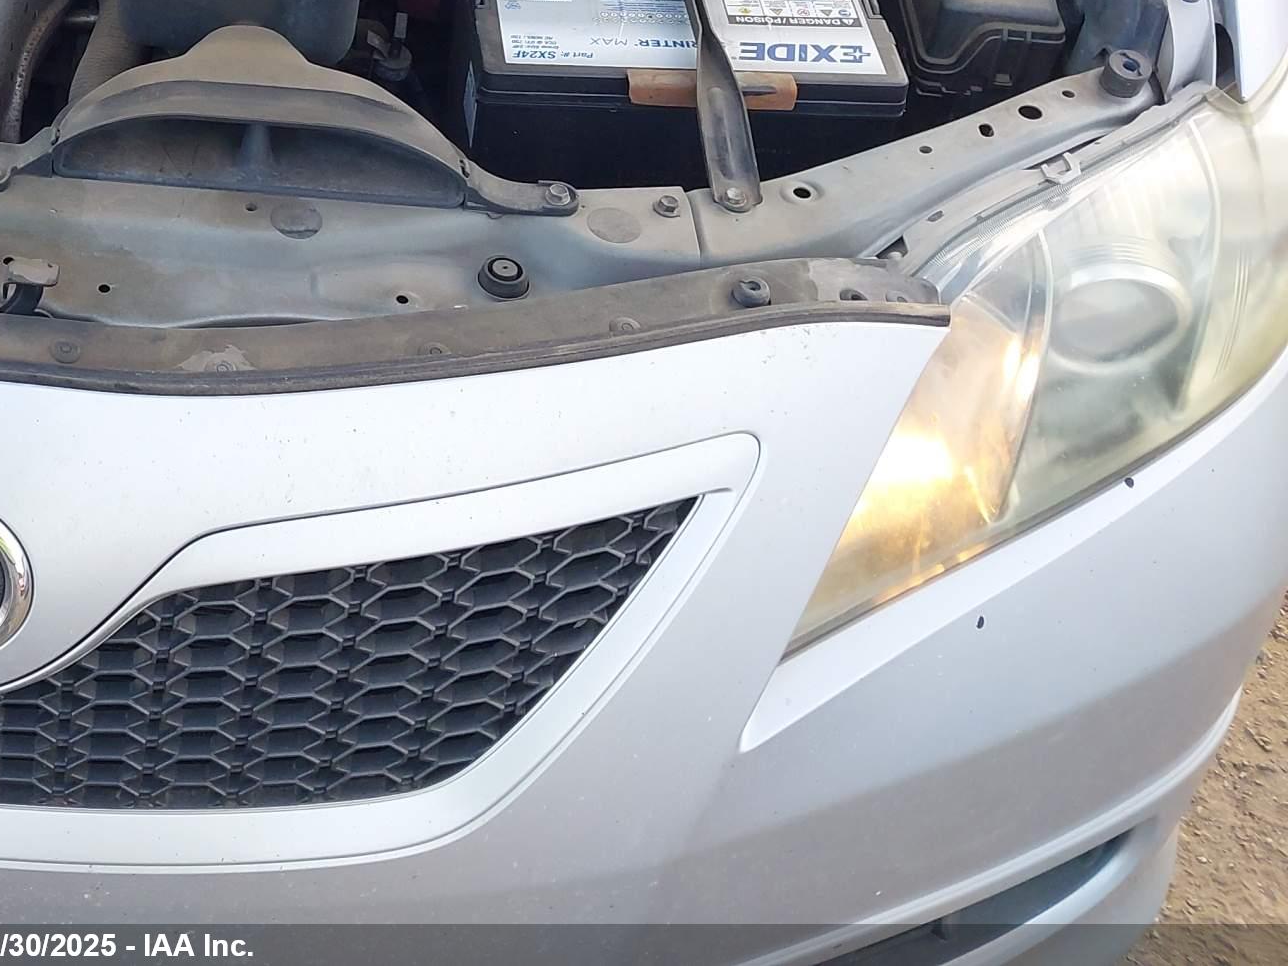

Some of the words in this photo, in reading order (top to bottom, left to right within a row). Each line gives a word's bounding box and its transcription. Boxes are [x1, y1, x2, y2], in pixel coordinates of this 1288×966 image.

[736, 16, 781, 25] POISON
[789, 17, 839, 26] DANGER
[590, 37, 628, 46] MAX
[638, 38, 699, 49] RINTER
[513, 50, 557, 60] SX24F
[573, 51, 593, 59] Part
[738, 42, 871, 64] EXIDE
